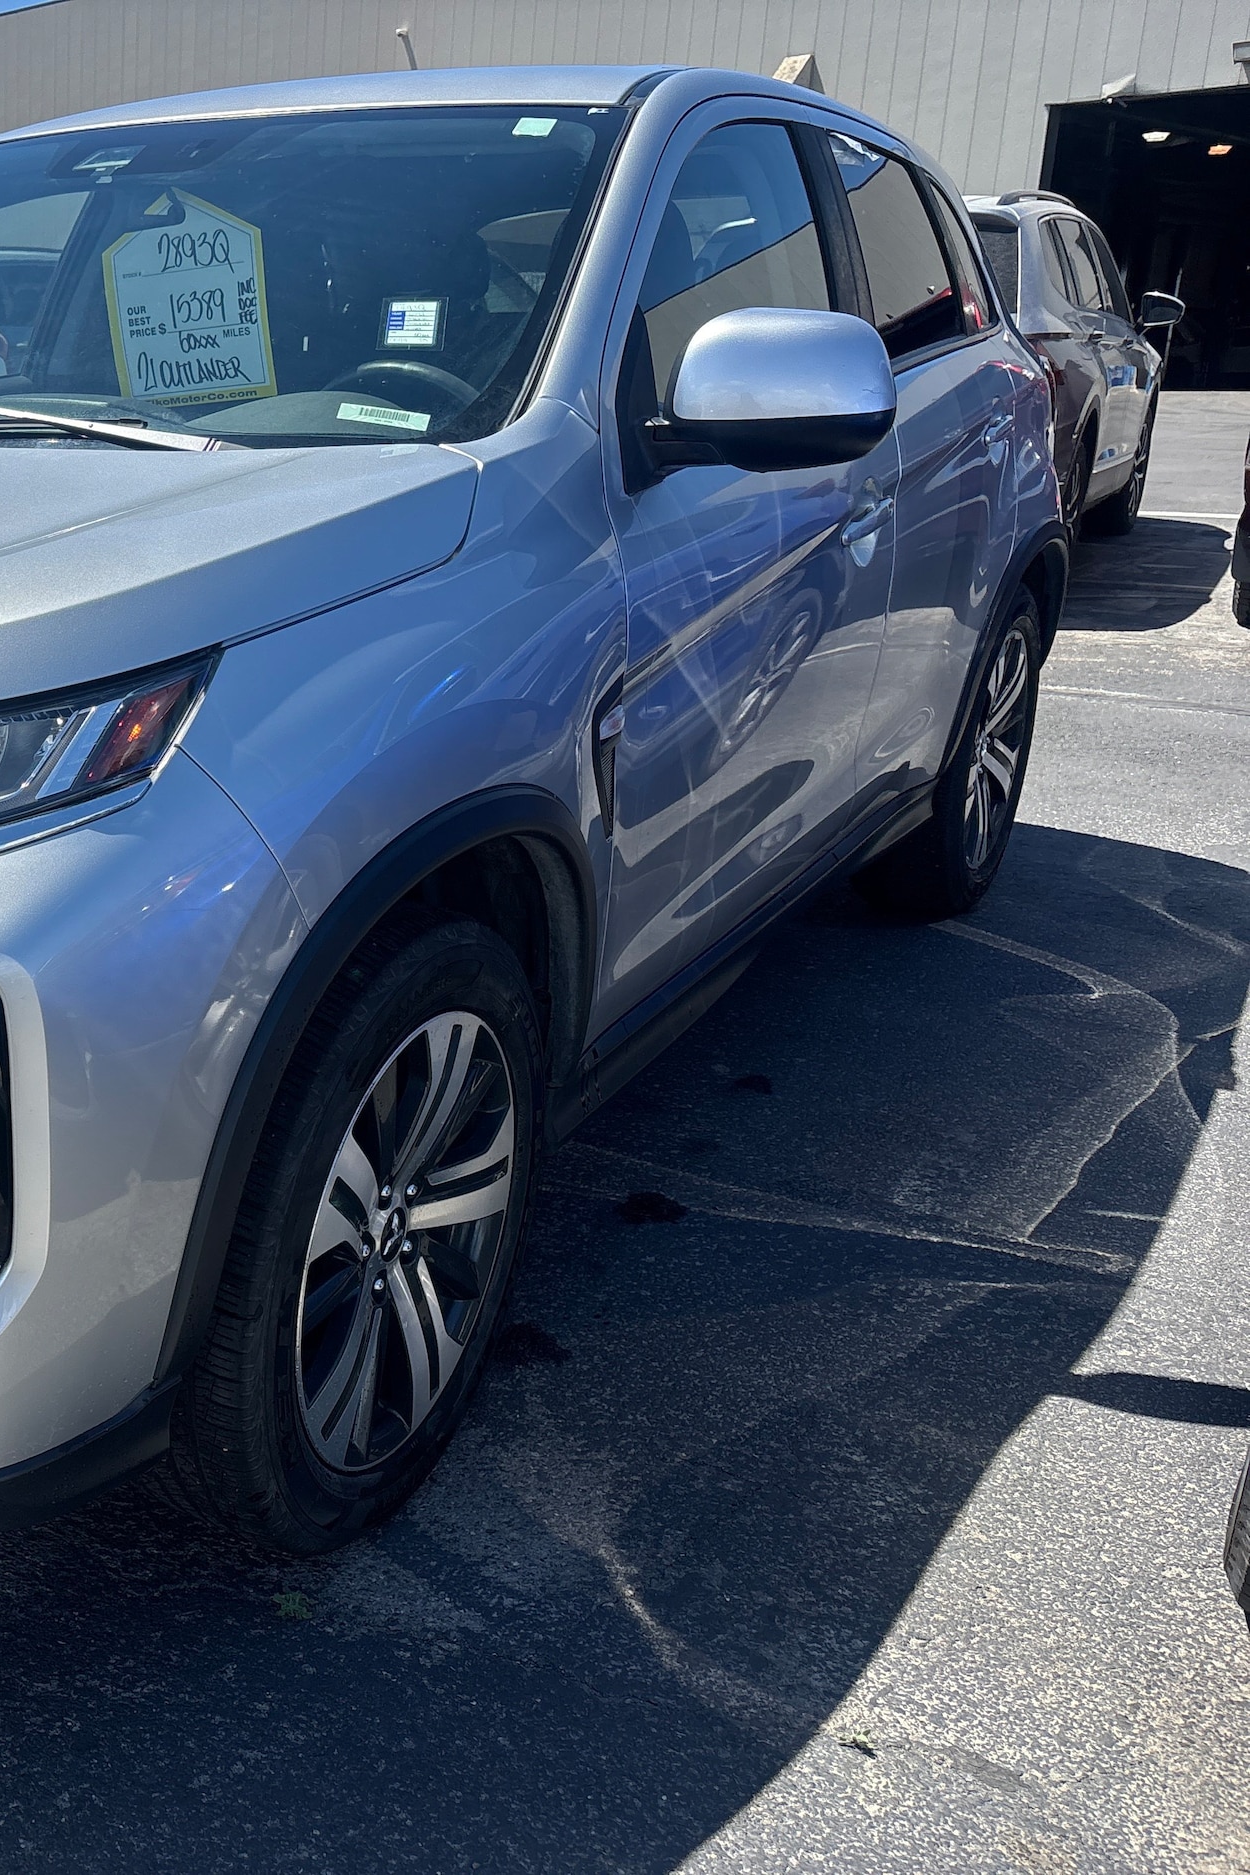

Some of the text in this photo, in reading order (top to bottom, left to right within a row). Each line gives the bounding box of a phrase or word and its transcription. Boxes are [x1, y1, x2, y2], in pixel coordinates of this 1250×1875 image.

[237, 277, 256, 298] INC
[127, 305, 147, 316] OUR
[170, 288, 227, 330] 15389
[238, 309, 258, 325] FEE
[128, 316, 151, 328] BEST
[129, 322, 167, 339] PRICE $
[222, 326, 251, 339] MILES
[137, 351, 252, 392] 21 OUTLANDER
